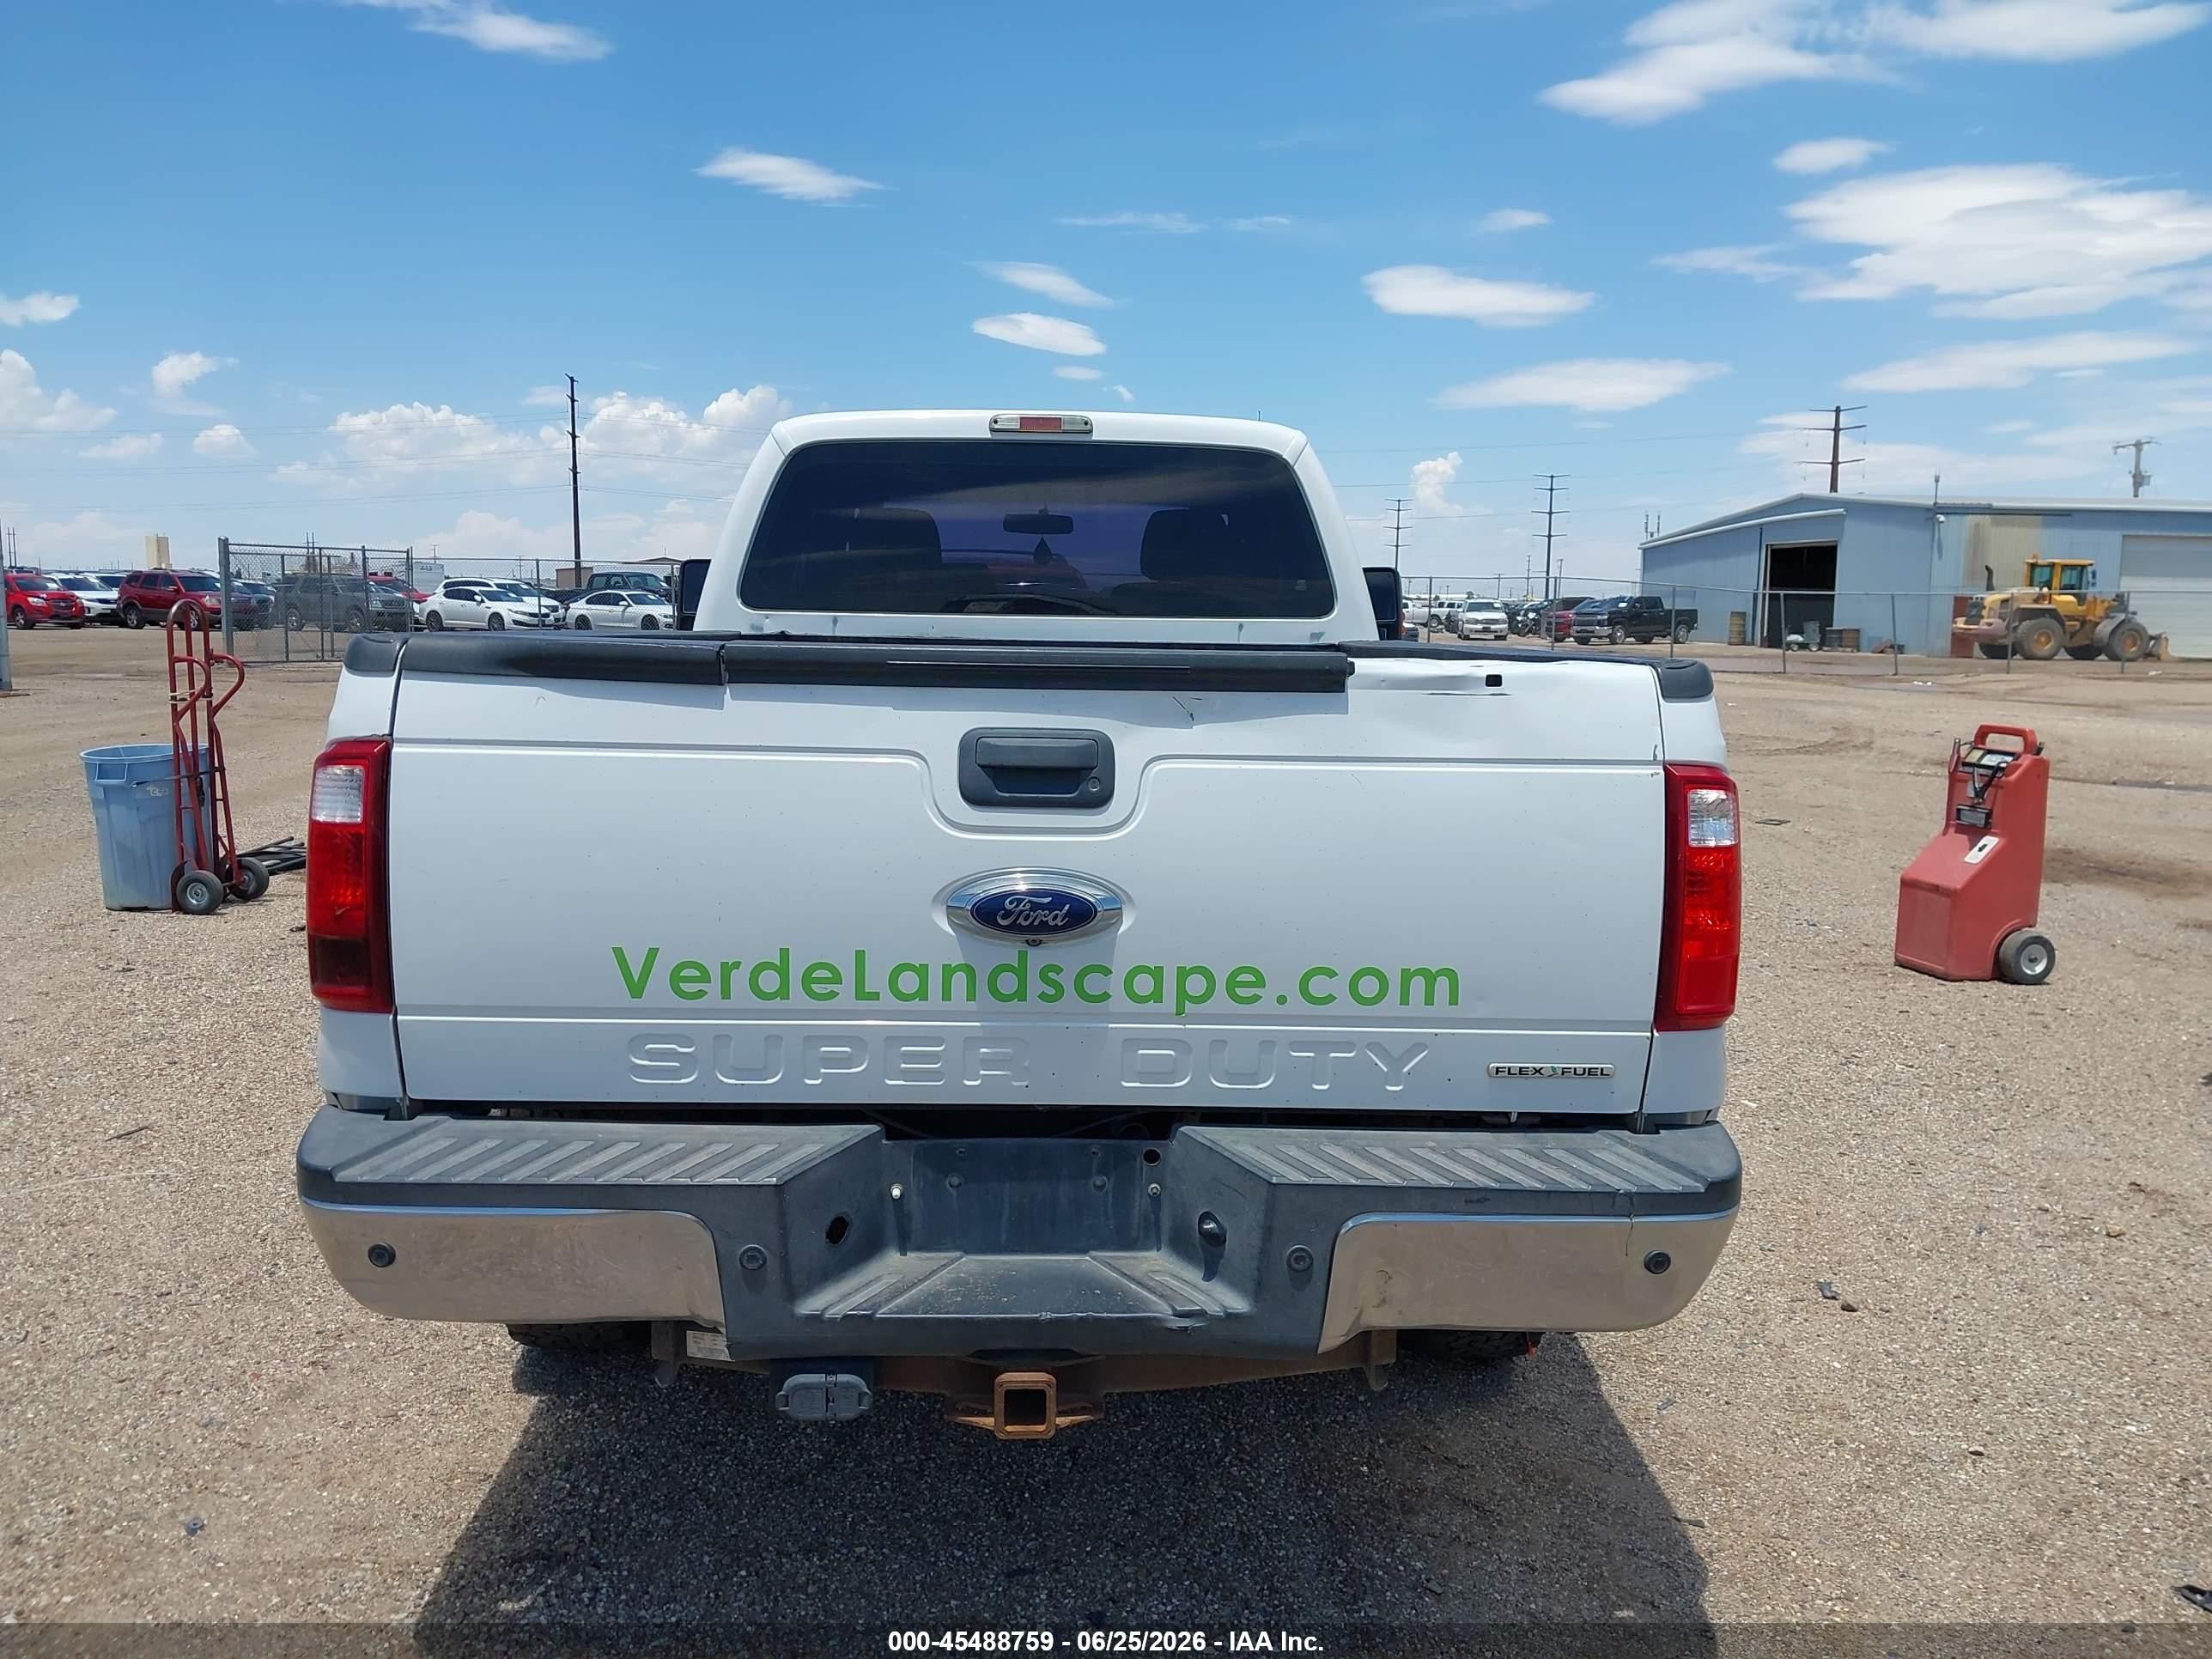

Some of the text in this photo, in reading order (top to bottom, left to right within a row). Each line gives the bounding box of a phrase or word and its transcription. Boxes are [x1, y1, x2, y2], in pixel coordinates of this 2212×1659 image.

[996, 895, 1071, 927] Ford
[611, 946, 1460, 1017] VerdeLandscape.com
[628, 1033, 1430, 1091] SUPER DUTY
[1494, 1066, 1611, 1078] FLEX FUEL
